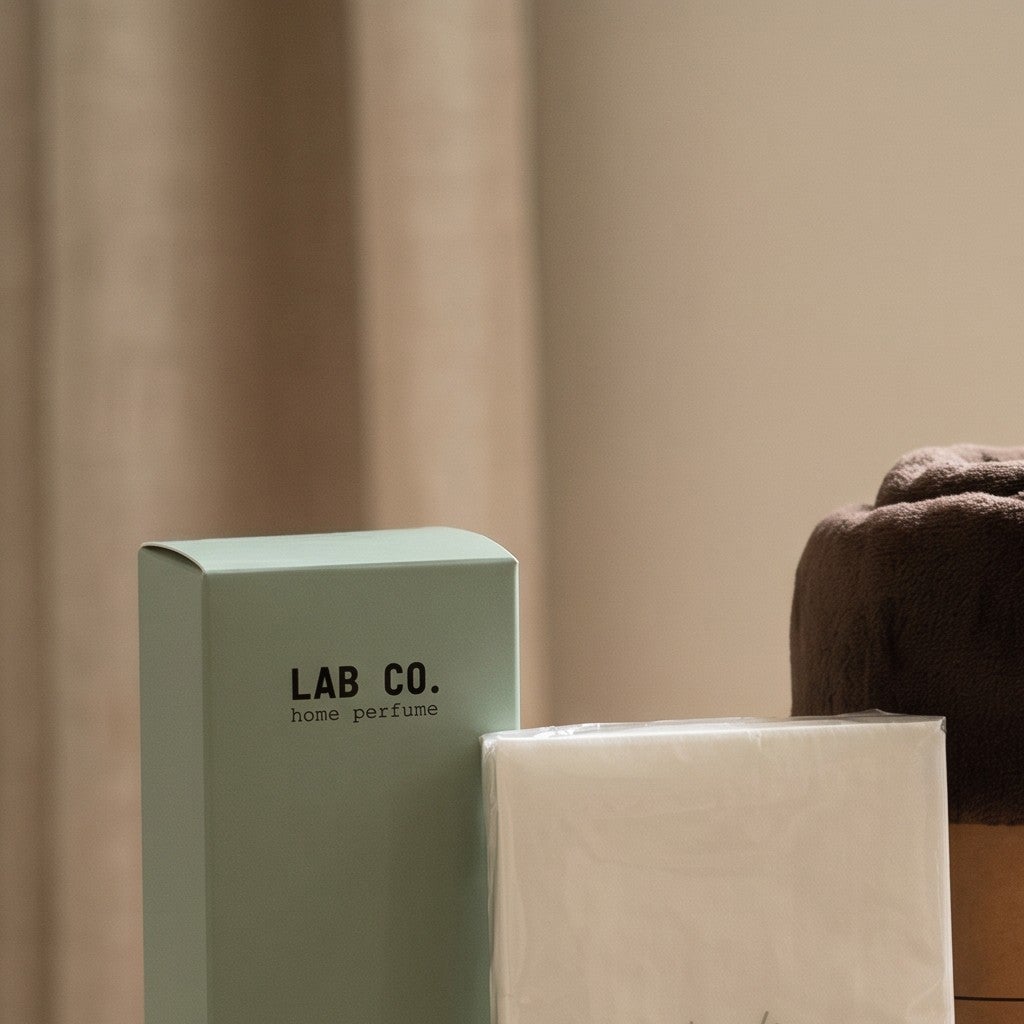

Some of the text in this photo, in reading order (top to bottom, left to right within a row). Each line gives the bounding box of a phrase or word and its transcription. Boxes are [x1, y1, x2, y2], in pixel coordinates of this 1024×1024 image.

[292, 662, 439, 700] LAB CO.
[291, 703, 438, 723] home perfume
